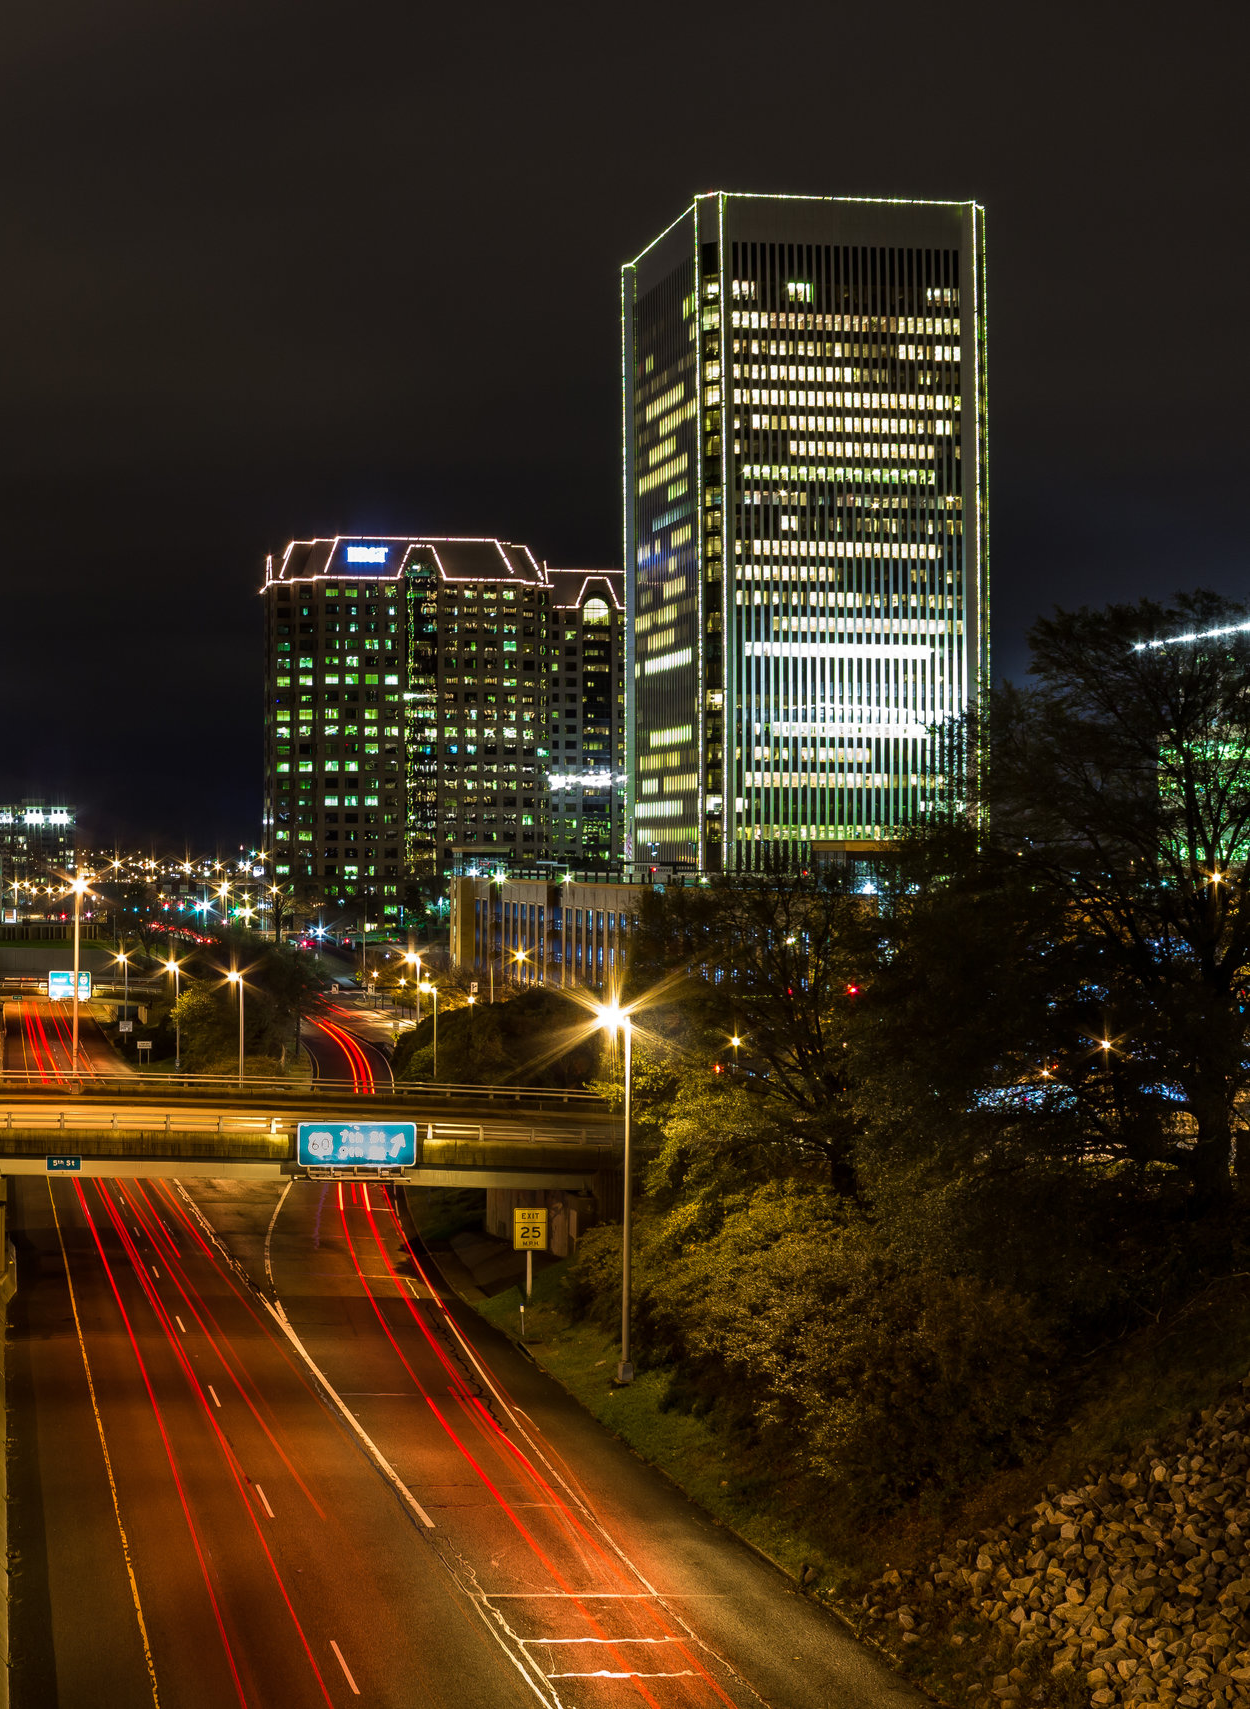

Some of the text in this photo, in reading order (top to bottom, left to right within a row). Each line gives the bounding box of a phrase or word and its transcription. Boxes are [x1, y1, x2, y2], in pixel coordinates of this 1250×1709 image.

[311, 1138, 330, 1151] 60
[52, 1159, 76, 1167] 5th St
[520, 1226, 541, 1239] 25
